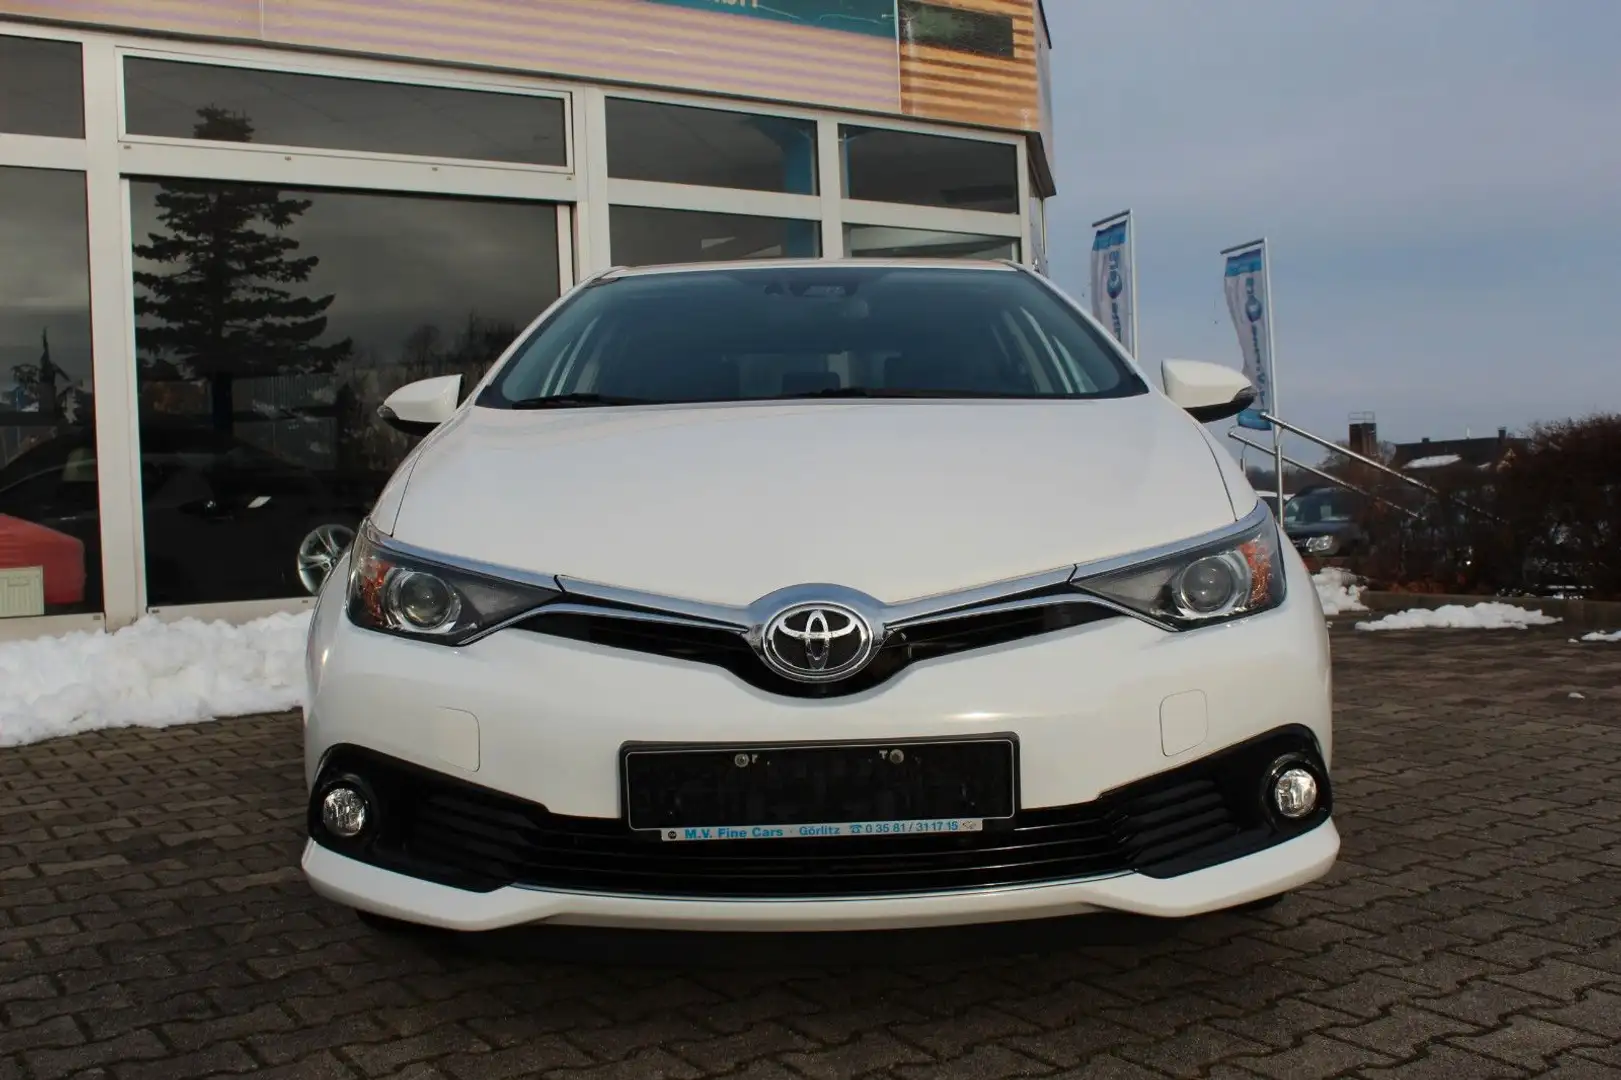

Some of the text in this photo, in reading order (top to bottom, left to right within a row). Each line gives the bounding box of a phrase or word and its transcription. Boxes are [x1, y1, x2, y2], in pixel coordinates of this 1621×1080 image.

[684, 829, 712, 839] M.V.
[717, 828, 747, 838] Fine
[752, 827, 783, 837] Cars
[799, 825, 840, 835] Görlitz
